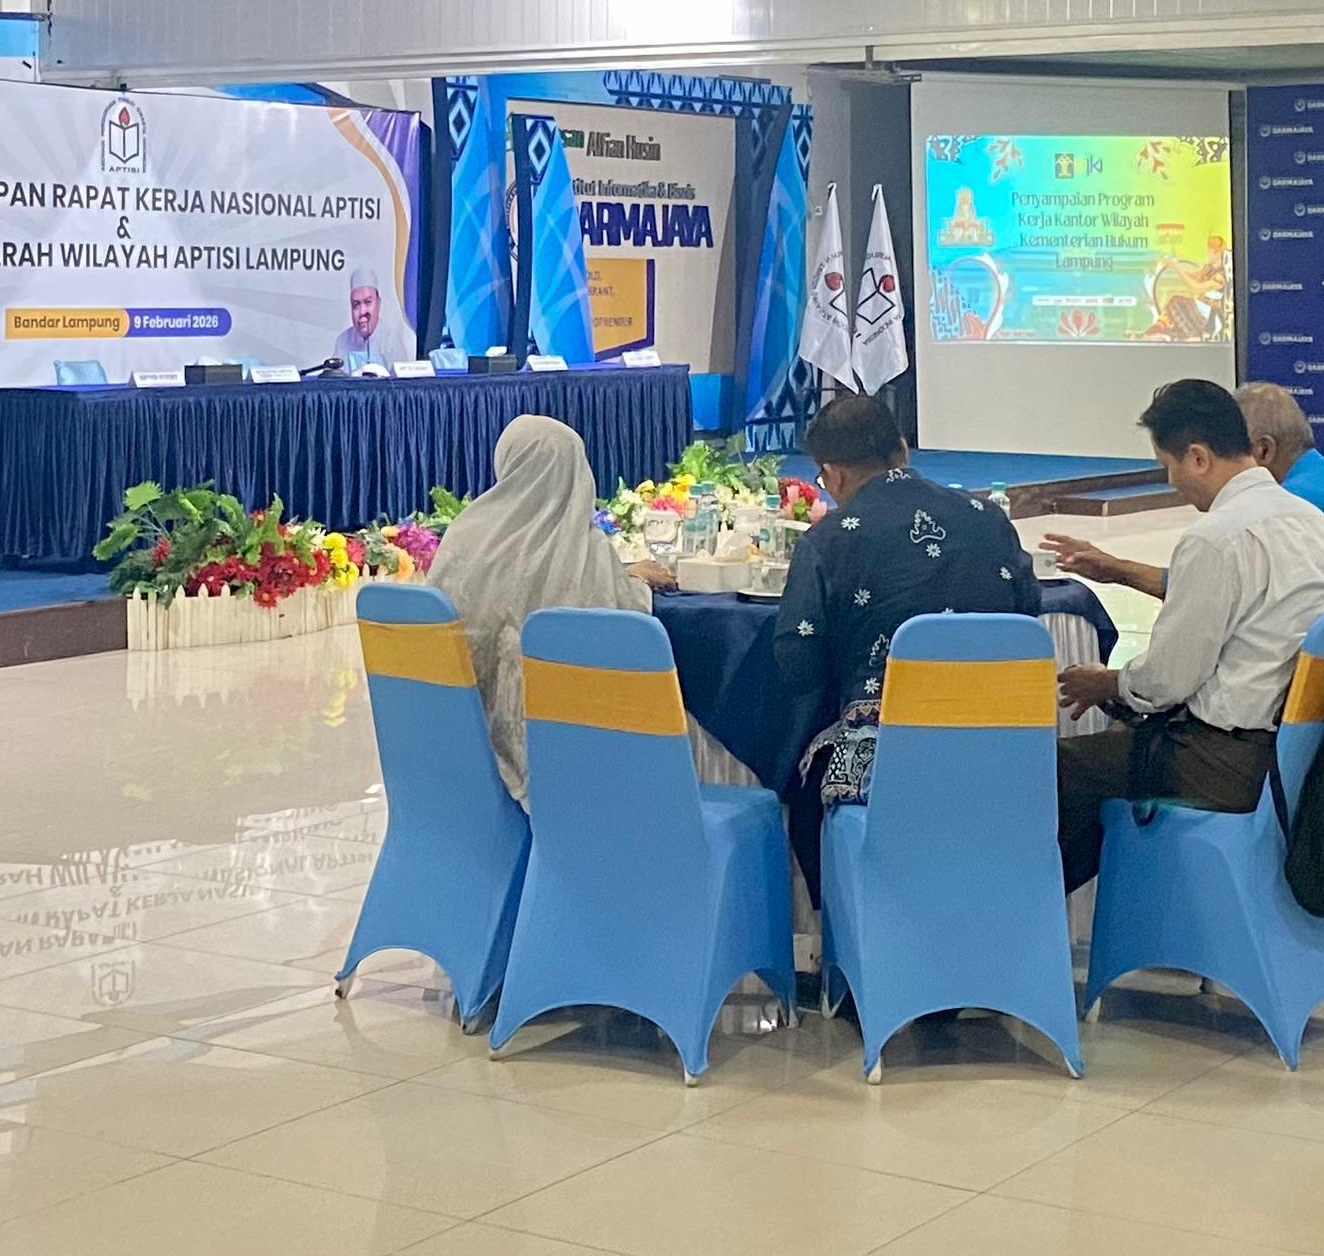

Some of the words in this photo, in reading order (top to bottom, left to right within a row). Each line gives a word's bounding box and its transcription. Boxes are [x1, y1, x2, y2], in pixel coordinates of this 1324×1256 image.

[109, 166, 140, 174] APTISI
[53, 184, 130, 211] RAPAT
[135, 187, 205, 214] KERJA
[211, 190, 316, 218] NASIONAL
[321, 196, 381, 220] APTISI
[1011, 192, 1096, 209] Penyampaian
[1098, 193, 1155, 210] Program
[116, 215, 132, 239] &
[580, 201, 714, 248] ARMAJAYA
[1018, 212, 1052, 229] Kerja
[1055, 212, 1099, 228] Kantor
[1100, 212, 1149, 230] Wilayah
[1020, 233, 1104, 248] Kementerian
[1105, 234, 1149, 249] Hukum
[60, 243, 168, 269] WILAYAH
[174, 246, 240, 270] APTISI
[246, 247, 345, 272] LAMPUNG
[1055, 252, 1114, 272] Lampung
[14, 315, 60, 329] Bandar
[62, 316, 120, 332] Lampung
[134, 315, 141, 329] 9
[143, 315, 190, 329] Februari
[192, 315, 219, 329] 2026
